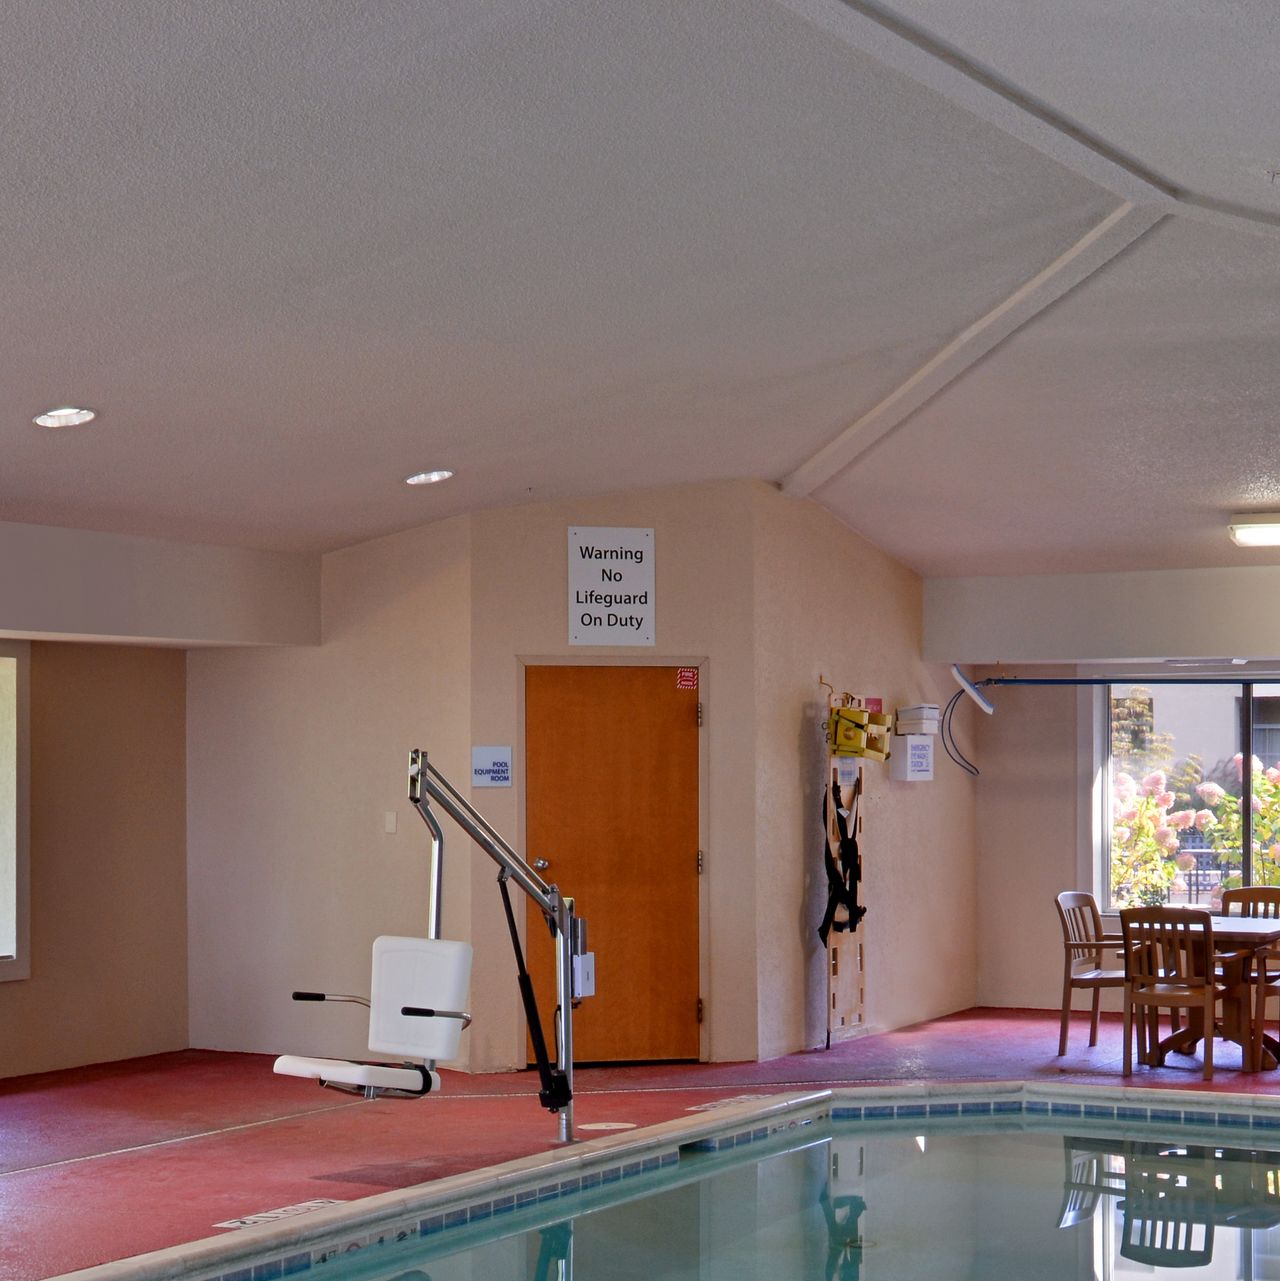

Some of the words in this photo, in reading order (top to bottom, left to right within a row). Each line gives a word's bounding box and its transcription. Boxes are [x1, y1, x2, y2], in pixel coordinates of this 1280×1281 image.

[579, 545, 643, 564] Warning
[601, 568, 623, 582] No
[576, 589, 648, 608] Lifeguard
[580, 612, 603, 627] On
[607, 613, 644, 630] Duty
